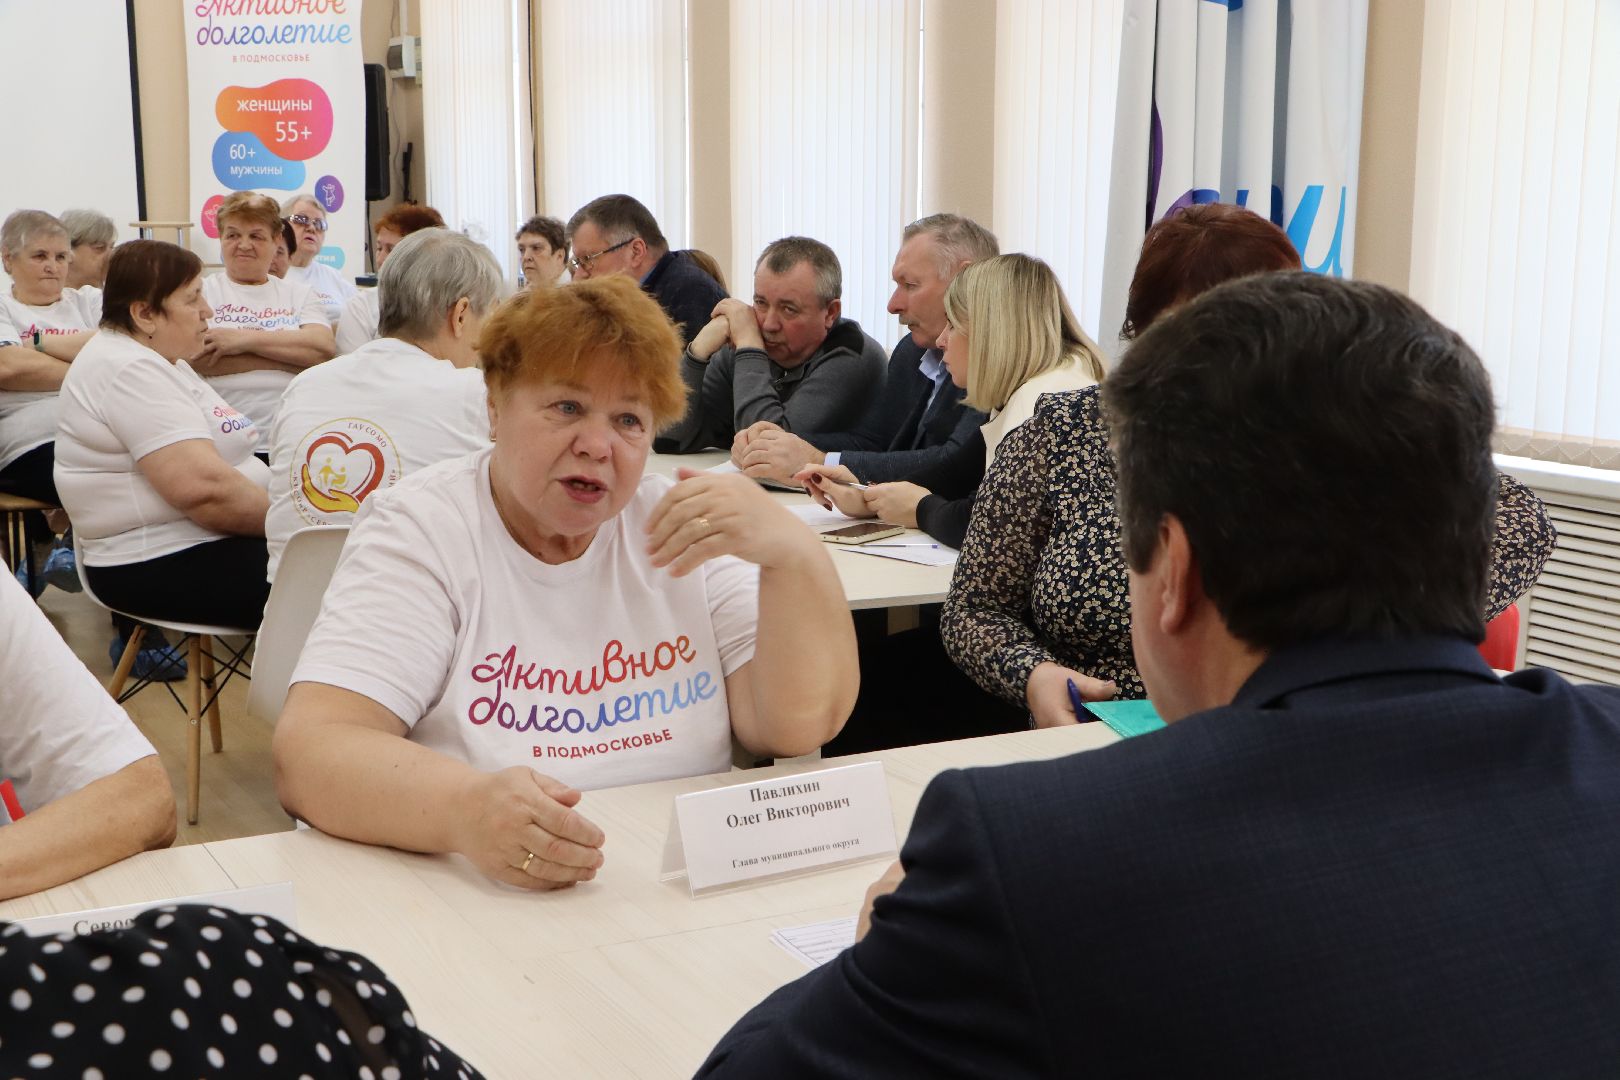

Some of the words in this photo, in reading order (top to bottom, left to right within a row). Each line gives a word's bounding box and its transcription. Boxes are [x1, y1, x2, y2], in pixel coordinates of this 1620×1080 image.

[196, 14, 352, 46] долголетие
[240, 54, 311, 63] ПОДМОСКОВЬЕ
[236, 98, 312, 114] женщины
[275, 121, 312, 143] 55+
[229, 143, 256, 160] 60+
[230, 164, 283, 177] мужчины
[471, 635, 697, 695] Активное
[468, 671, 718, 733] долголетие
[533, 745, 543, 758] В
[547, 728, 673, 759] ПОДМОСКОВЬЕ
[750, 781, 821, 803] Павлихин
[726, 813, 762, 828] Олег
[766, 797, 851, 822] Викторович
[732, 857, 759, 869] Глава
[760, 843, 831, 865] муниципального
[832, 837, 860, 851] округа
